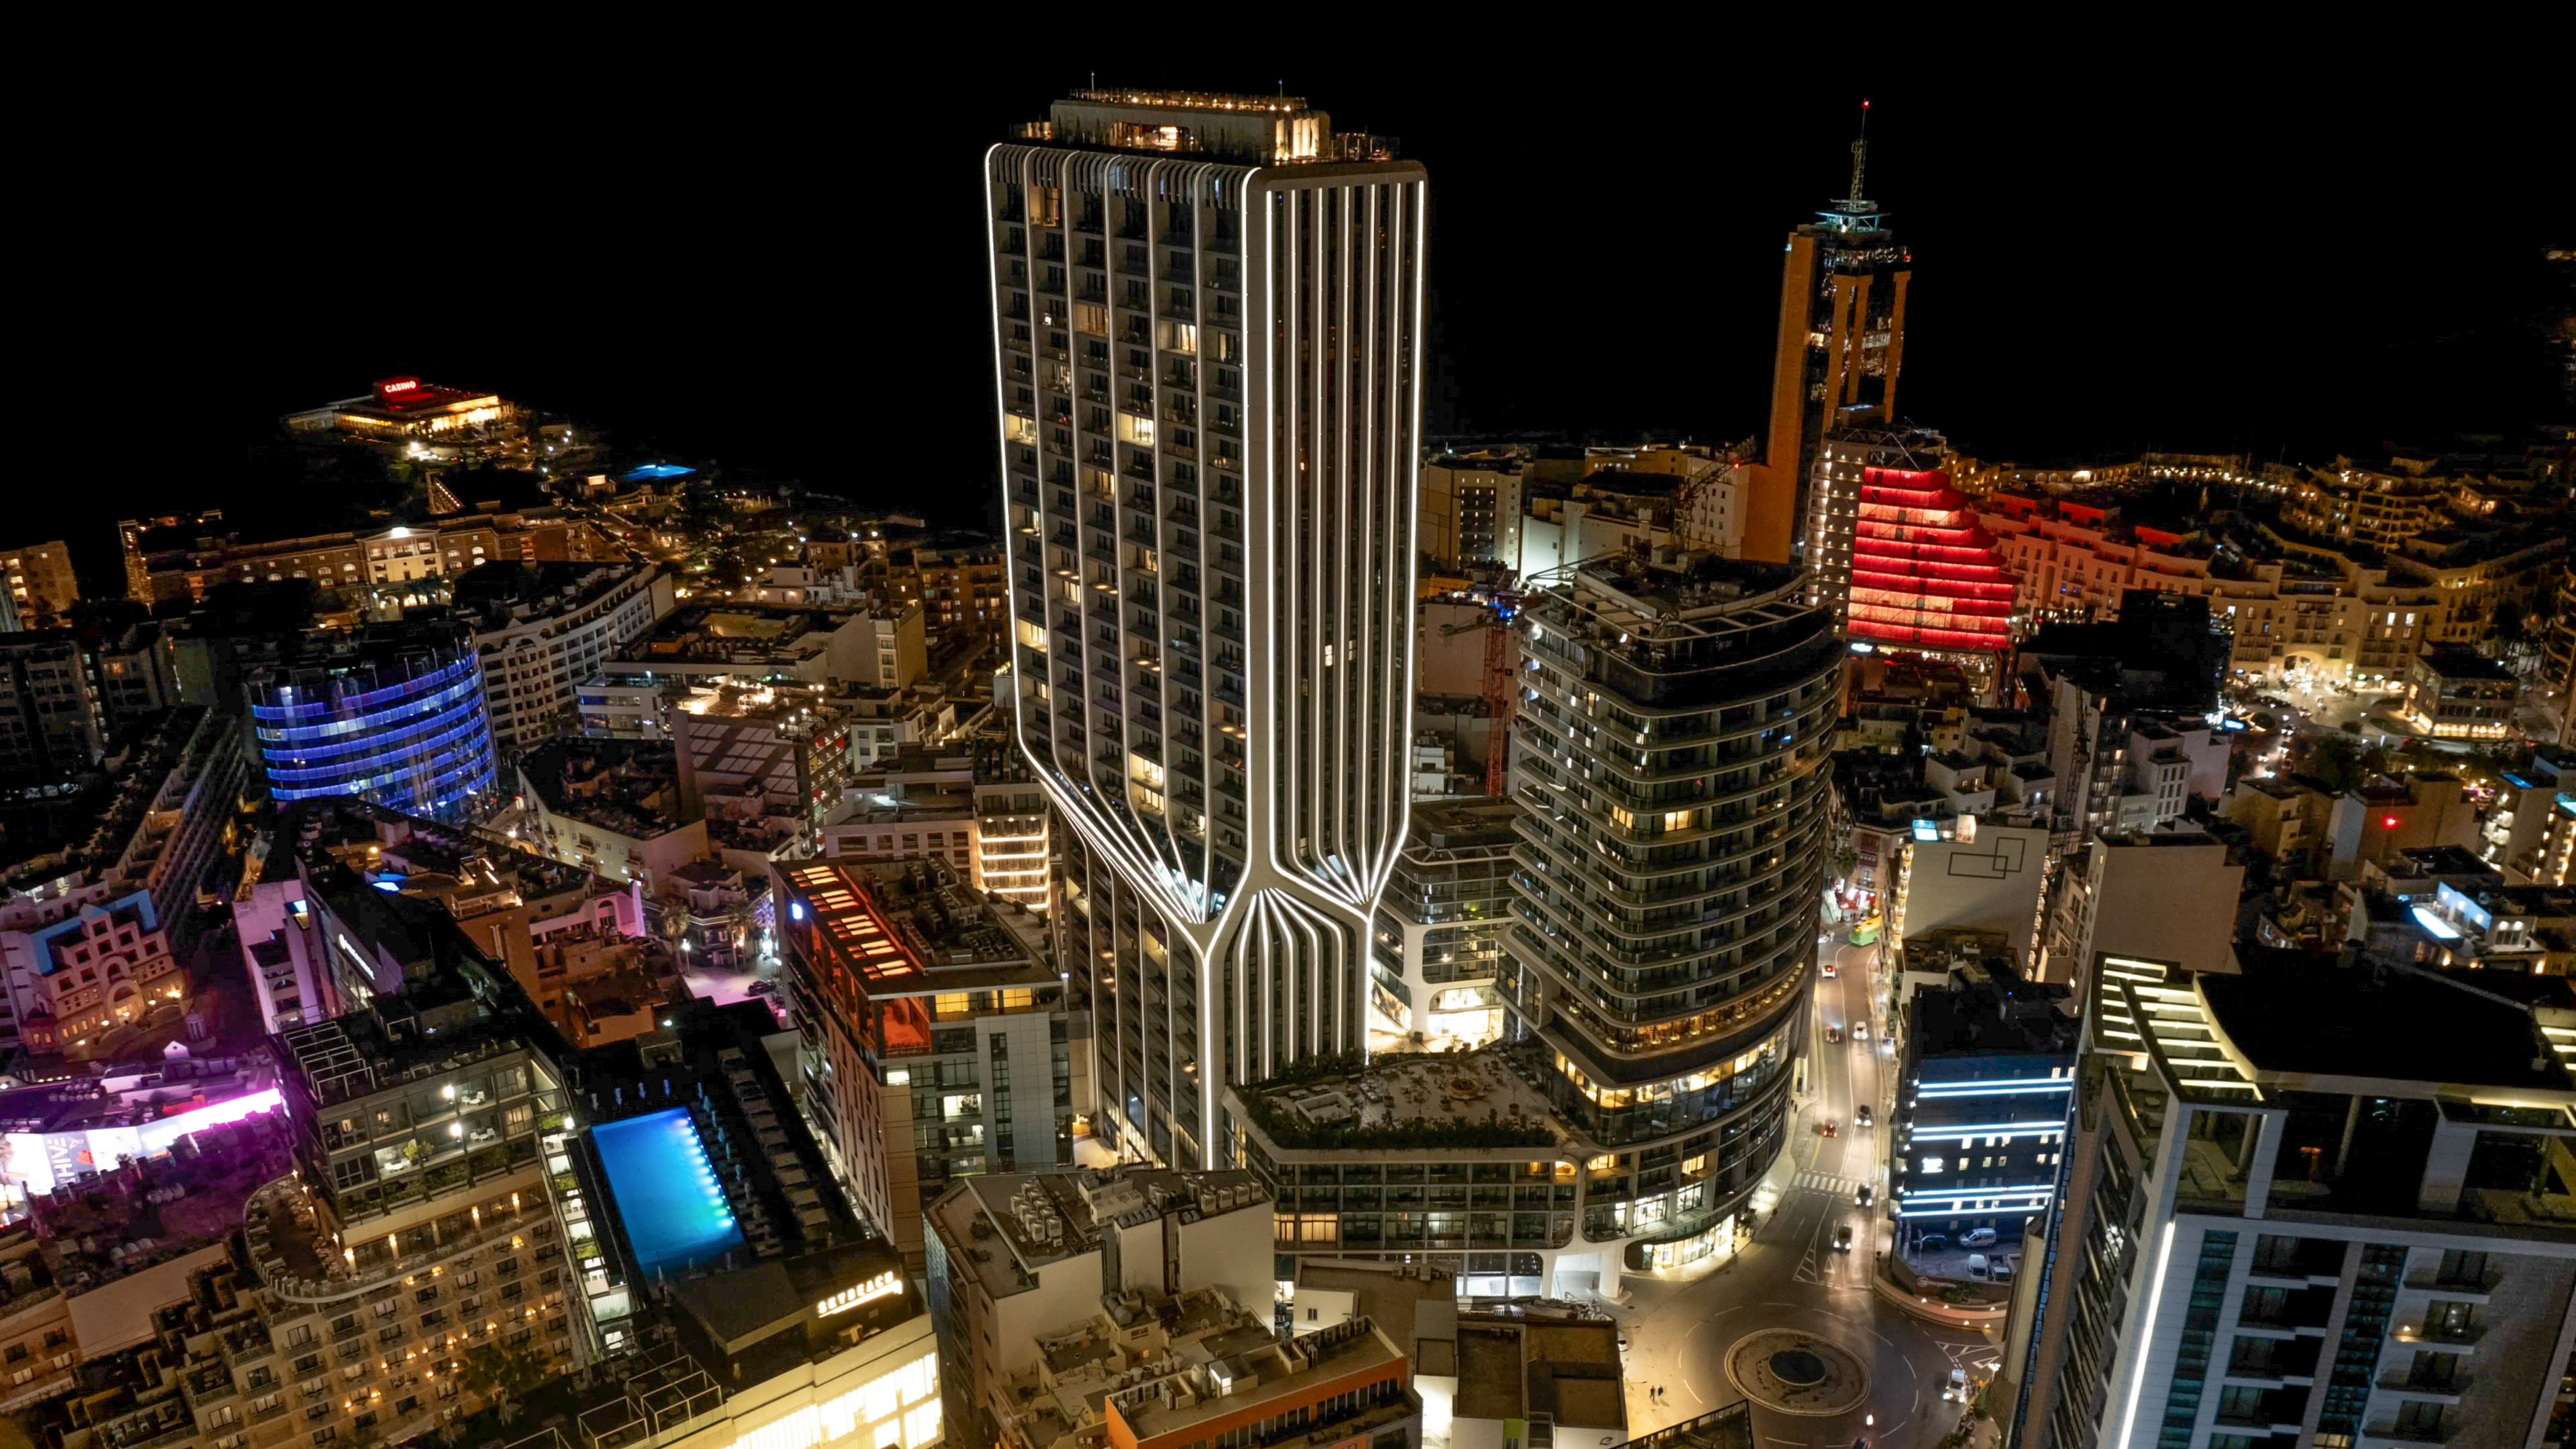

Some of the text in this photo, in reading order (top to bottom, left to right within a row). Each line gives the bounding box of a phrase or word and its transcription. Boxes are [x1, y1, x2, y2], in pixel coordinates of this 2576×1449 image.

[385, 380, 416, 393] CASINO
[47, 1137, 75, 1177] HIVE
[818, 1270, 894, 1314] SKYBEACH
